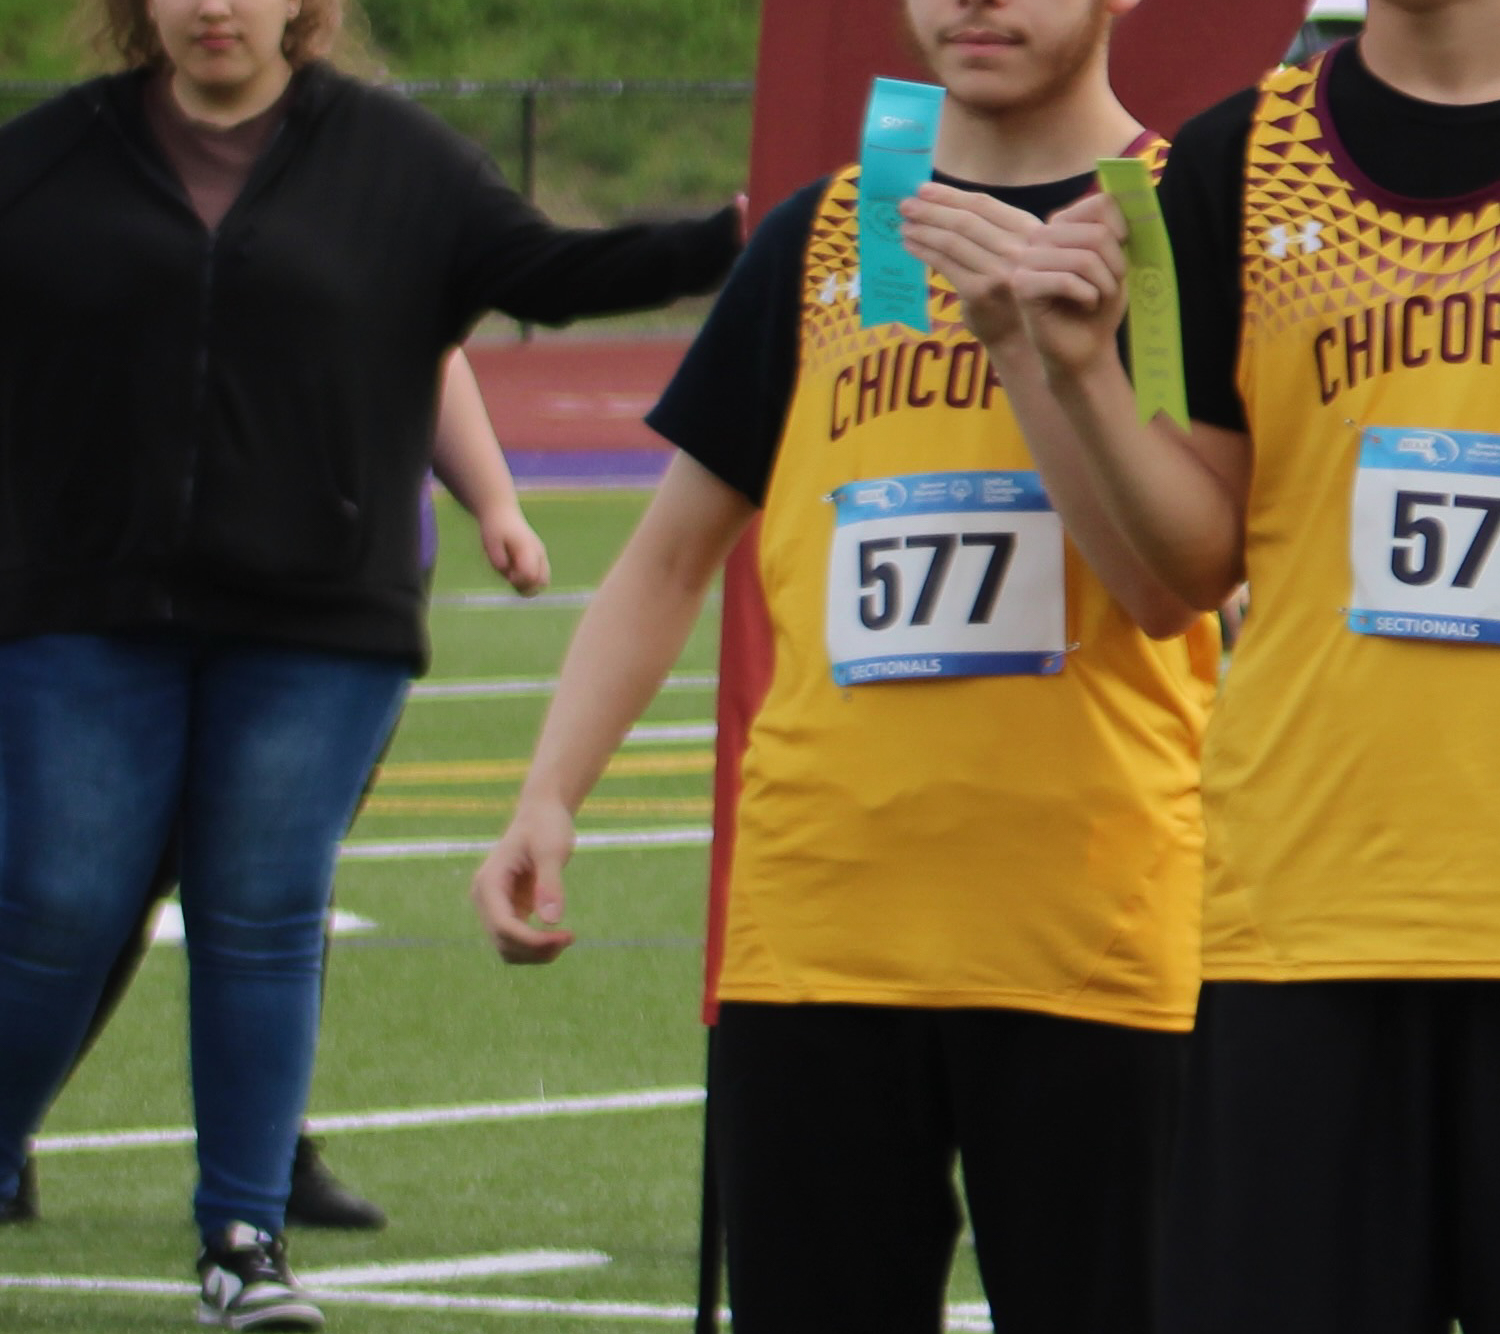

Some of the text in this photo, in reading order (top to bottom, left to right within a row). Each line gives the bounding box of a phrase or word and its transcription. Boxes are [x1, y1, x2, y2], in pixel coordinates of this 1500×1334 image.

[859, 532, 1018, 632] 577
[1375, 615, 1481, 638] SECTIONALS
[851, 658, 942, 681] SECTIONALS
